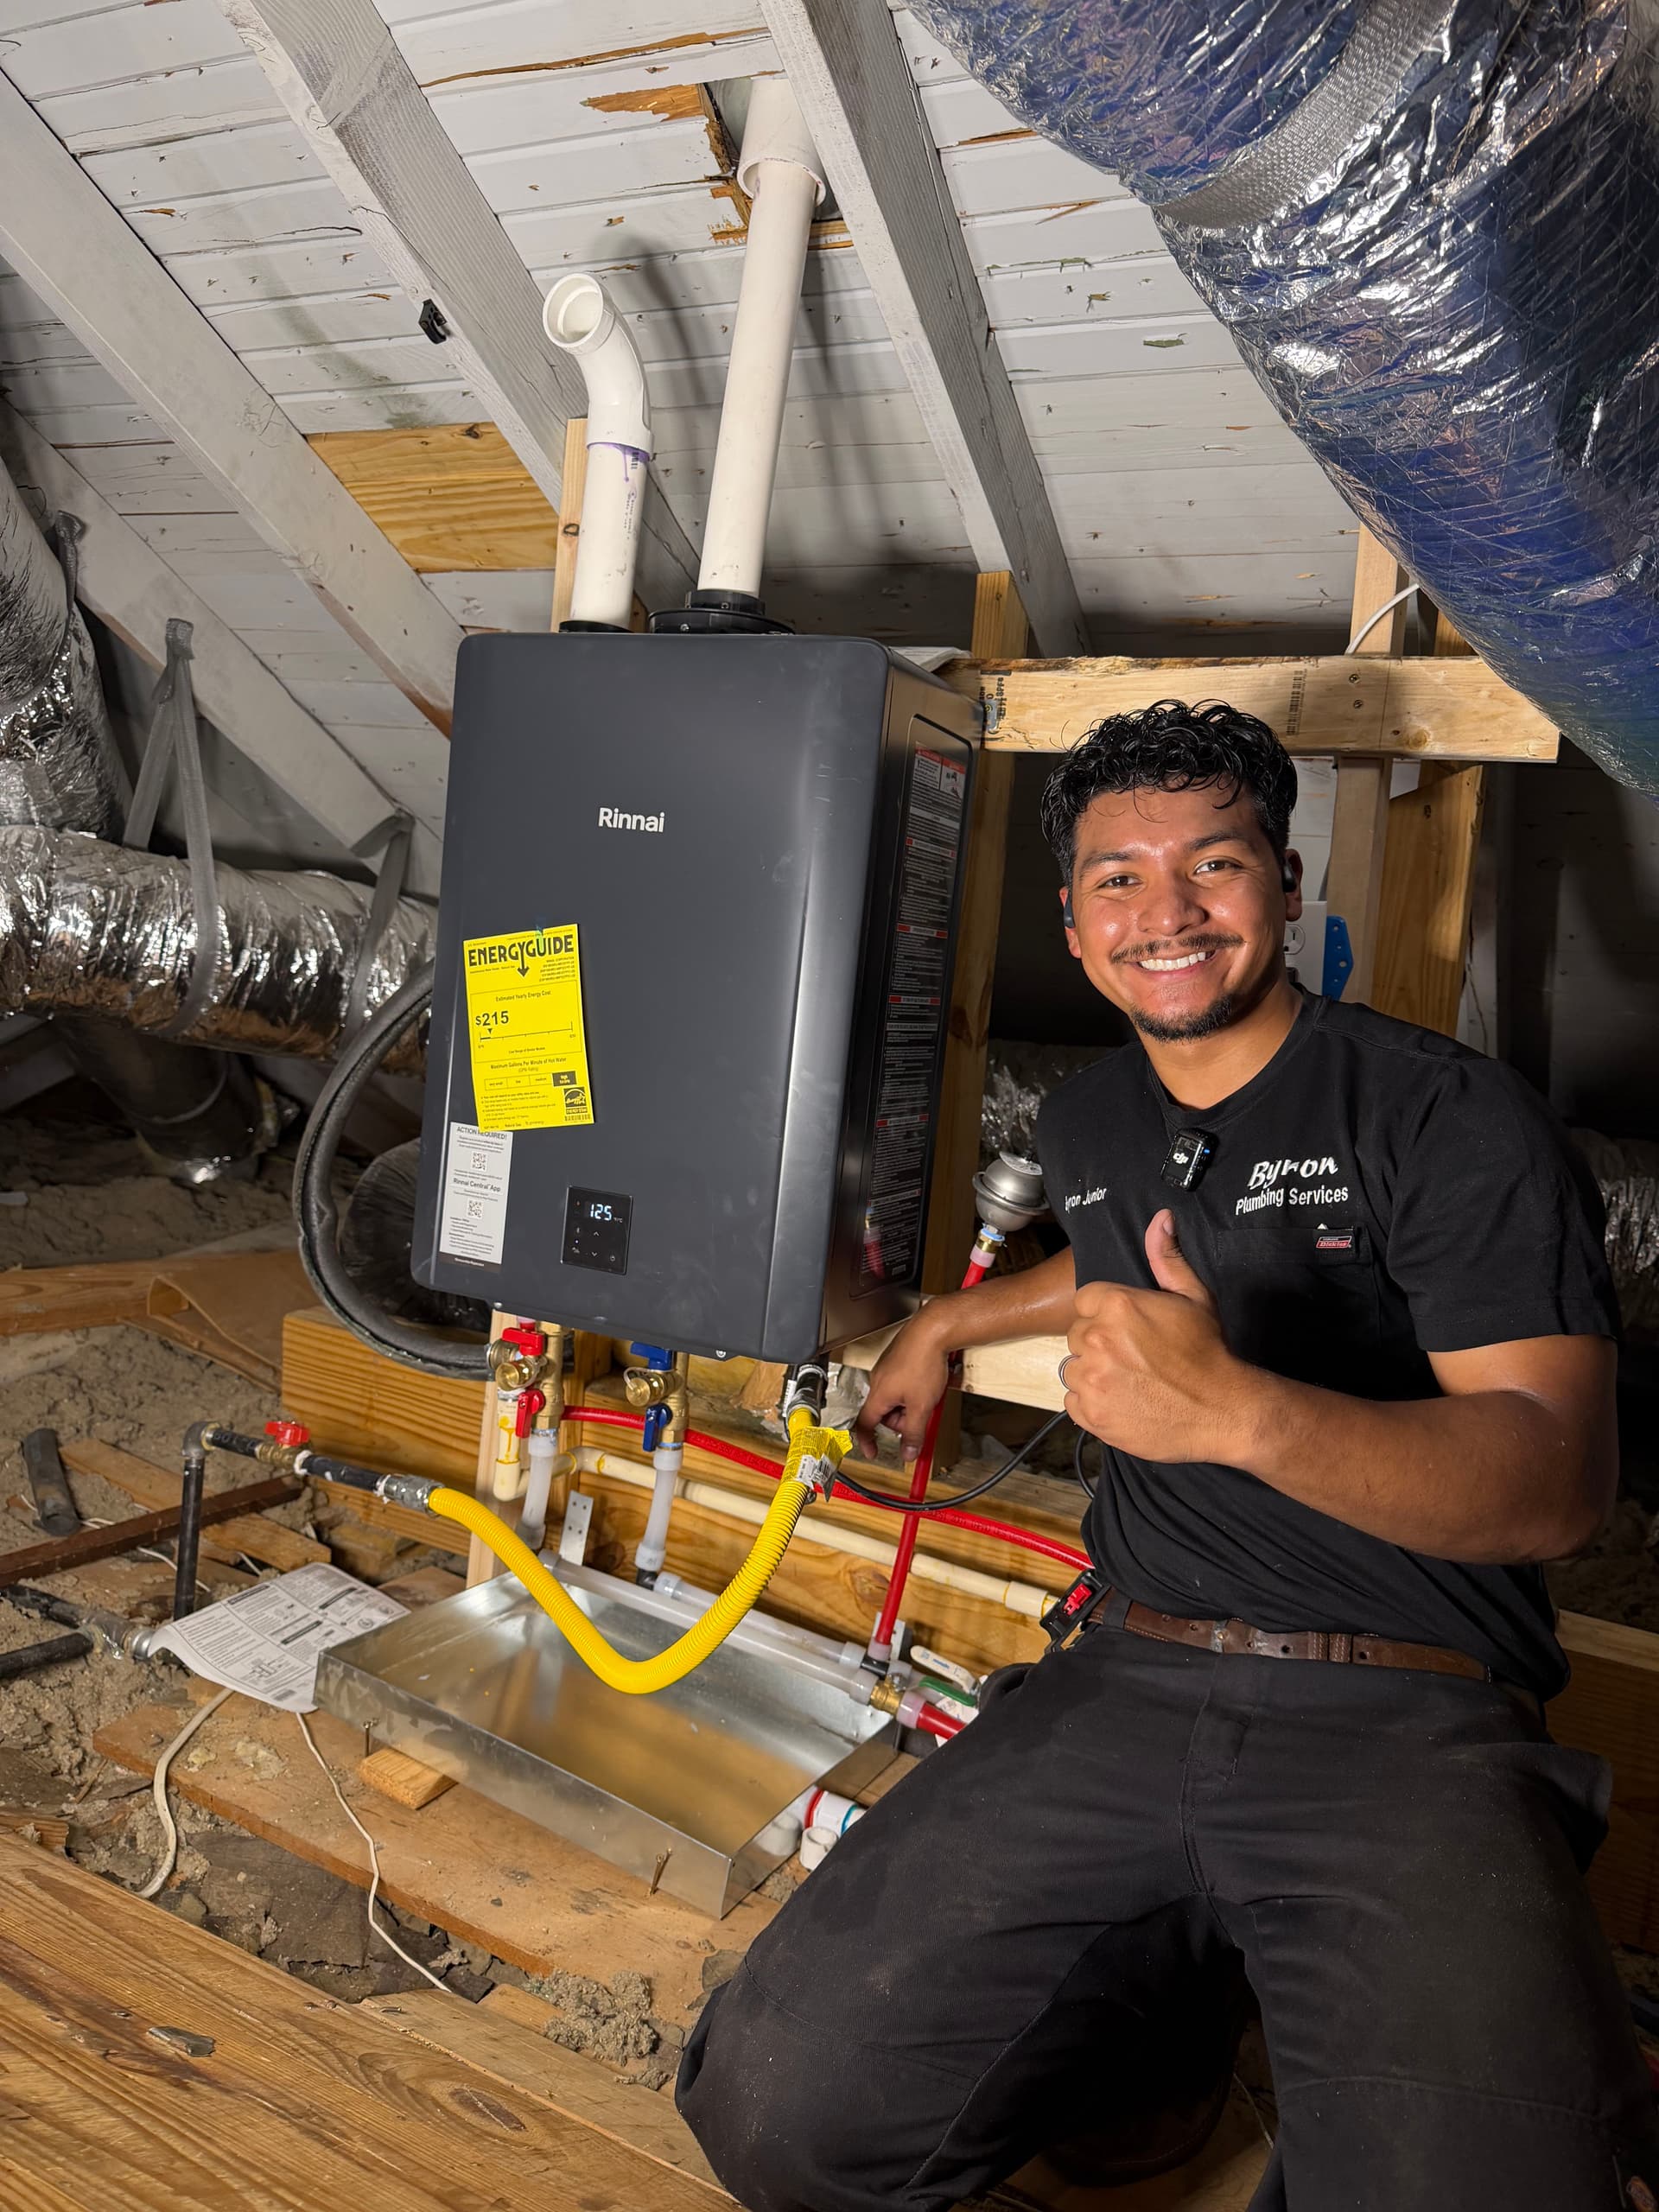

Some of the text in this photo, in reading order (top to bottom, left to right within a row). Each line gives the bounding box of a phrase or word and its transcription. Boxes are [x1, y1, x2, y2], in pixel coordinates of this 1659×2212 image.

[598, 807, 664, 832] Rinnai
[475, 1011, 509, 1027] $215
[457, 1126, 477, 1135] ACTION
[1247, 1156, 1338, 1191] Byron
[1082, 1187, 1107, 1205] Junior
[1235, 1185, 1348, 1216] Plumbing Services
[590, 1203, 612, 1221] 125
